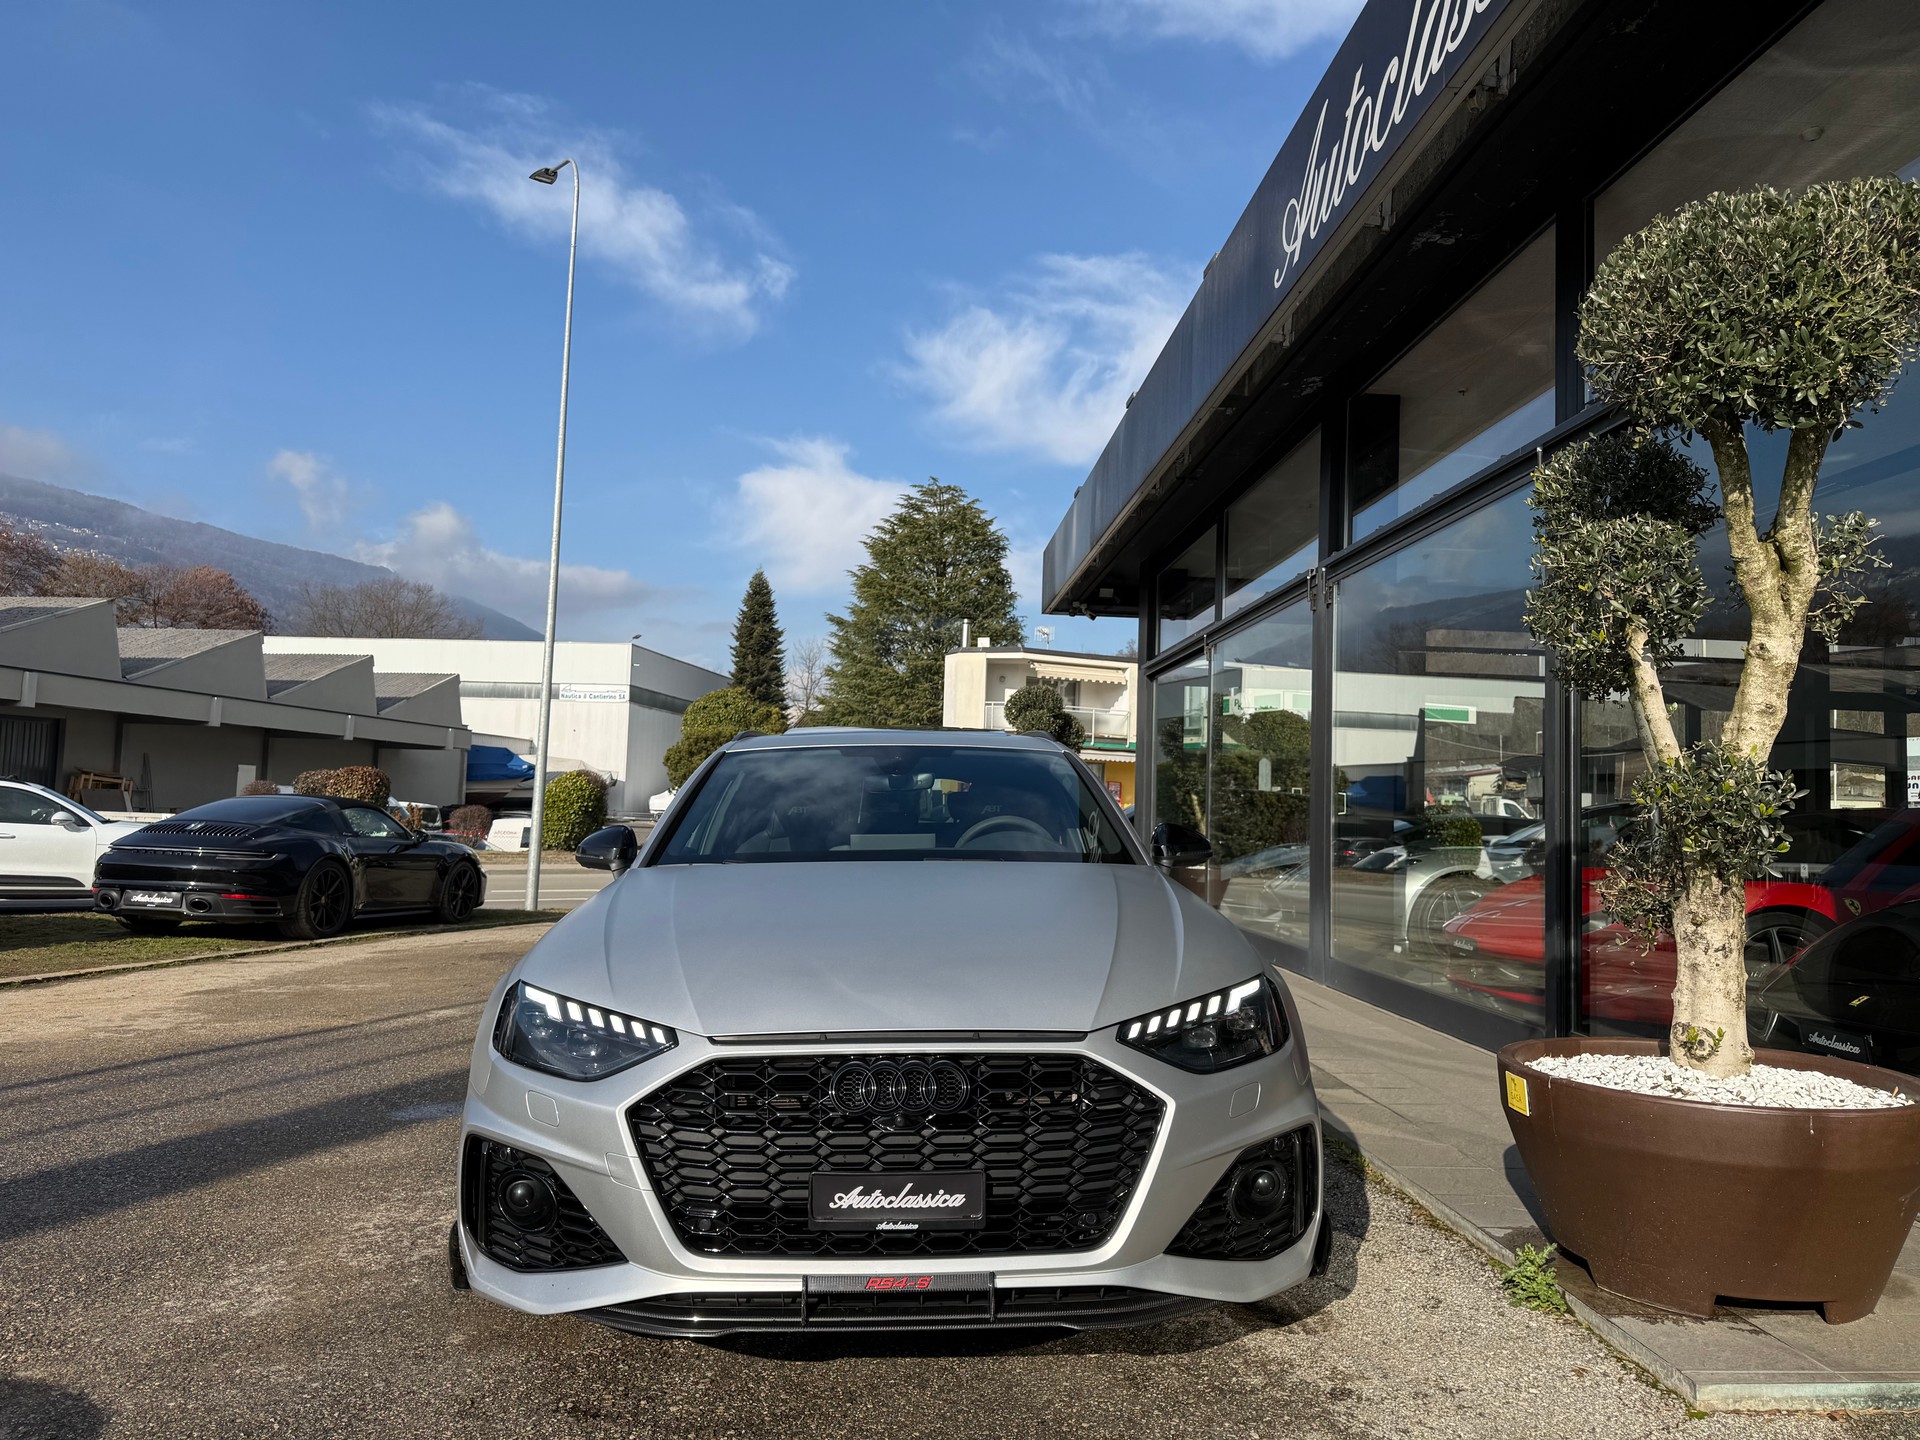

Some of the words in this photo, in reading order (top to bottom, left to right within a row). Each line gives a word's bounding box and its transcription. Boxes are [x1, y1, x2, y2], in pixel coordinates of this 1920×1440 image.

[1274, 0, 1492, 288] Autoclas
[1808, 1031, 1861, 1054] Autoclassica
[828, 1182, 967, 1210] Autoclassica
[875, 1220, 920, 1231] Autoclassica
[865, 1276, 933, 1290] RS4-S
